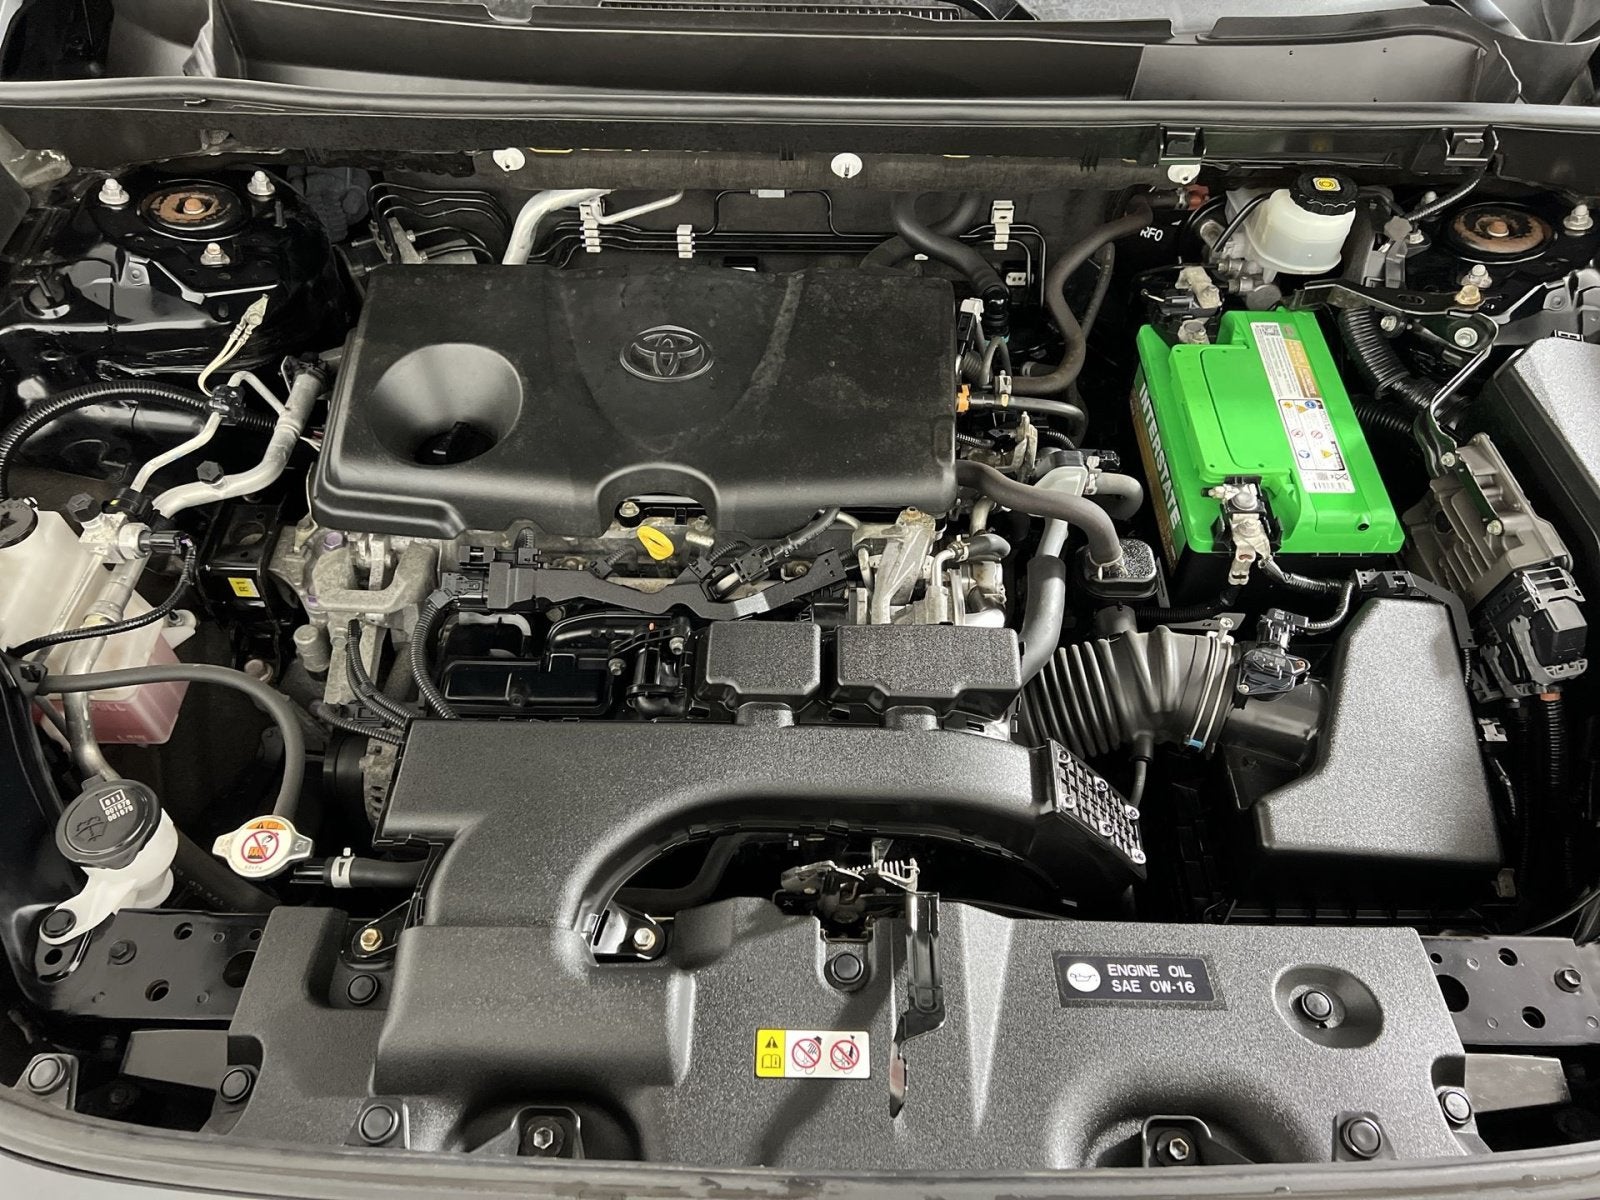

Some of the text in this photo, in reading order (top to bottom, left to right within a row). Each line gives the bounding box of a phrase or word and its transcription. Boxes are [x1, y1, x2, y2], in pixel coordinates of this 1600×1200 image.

[1139, 382, 1181, 530] INTERSTATE
[1106, 963, 1193, 978] ENGINE OIL
[1111, 979, 1142, 993] SAE
